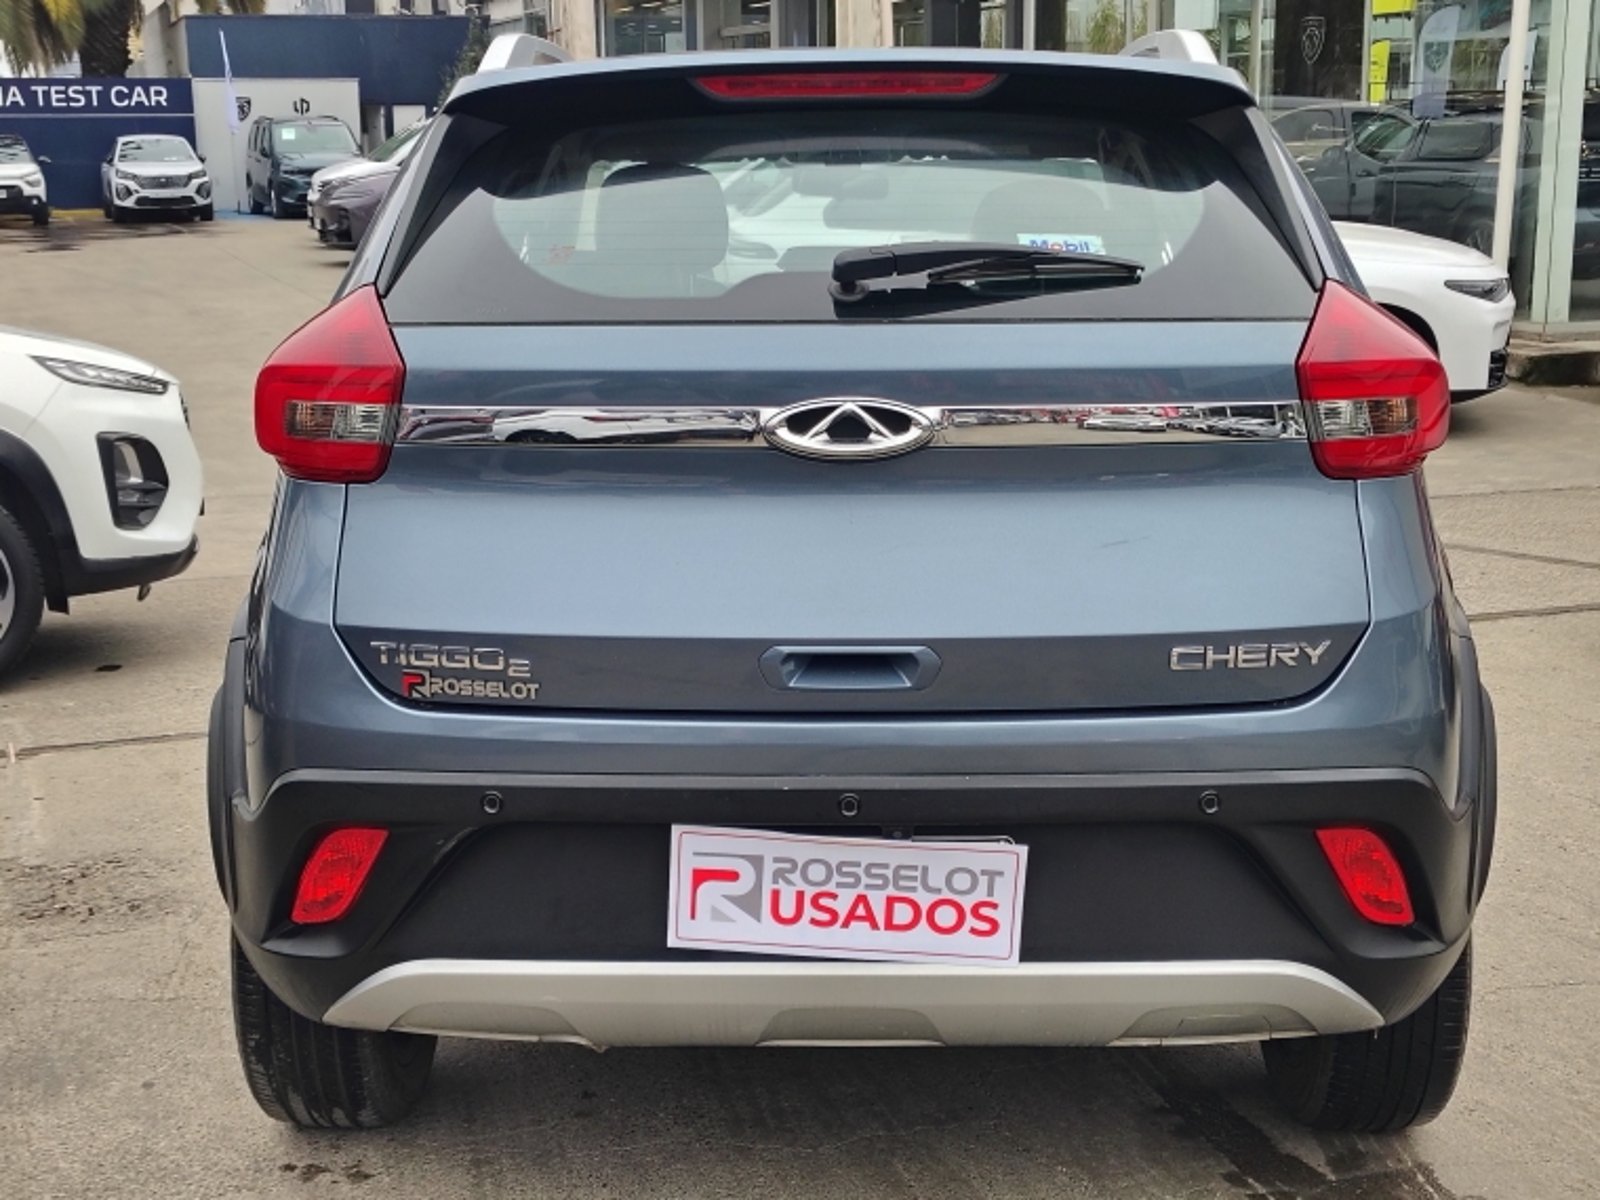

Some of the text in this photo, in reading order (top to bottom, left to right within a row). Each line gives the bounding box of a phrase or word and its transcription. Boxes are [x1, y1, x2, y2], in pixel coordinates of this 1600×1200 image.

[30, 86, 103, 107] TEST
[110, 86, 168, 107] CAR
[370, 641, 504, 671] TIGGO
[1170, 639, 1332, 671] CHERY
[430, 677, 540, 700] ROSSELOT
[771, 856, 1005, 897] ROSSELOT
[770, 888, 1000, 938] USADOS
